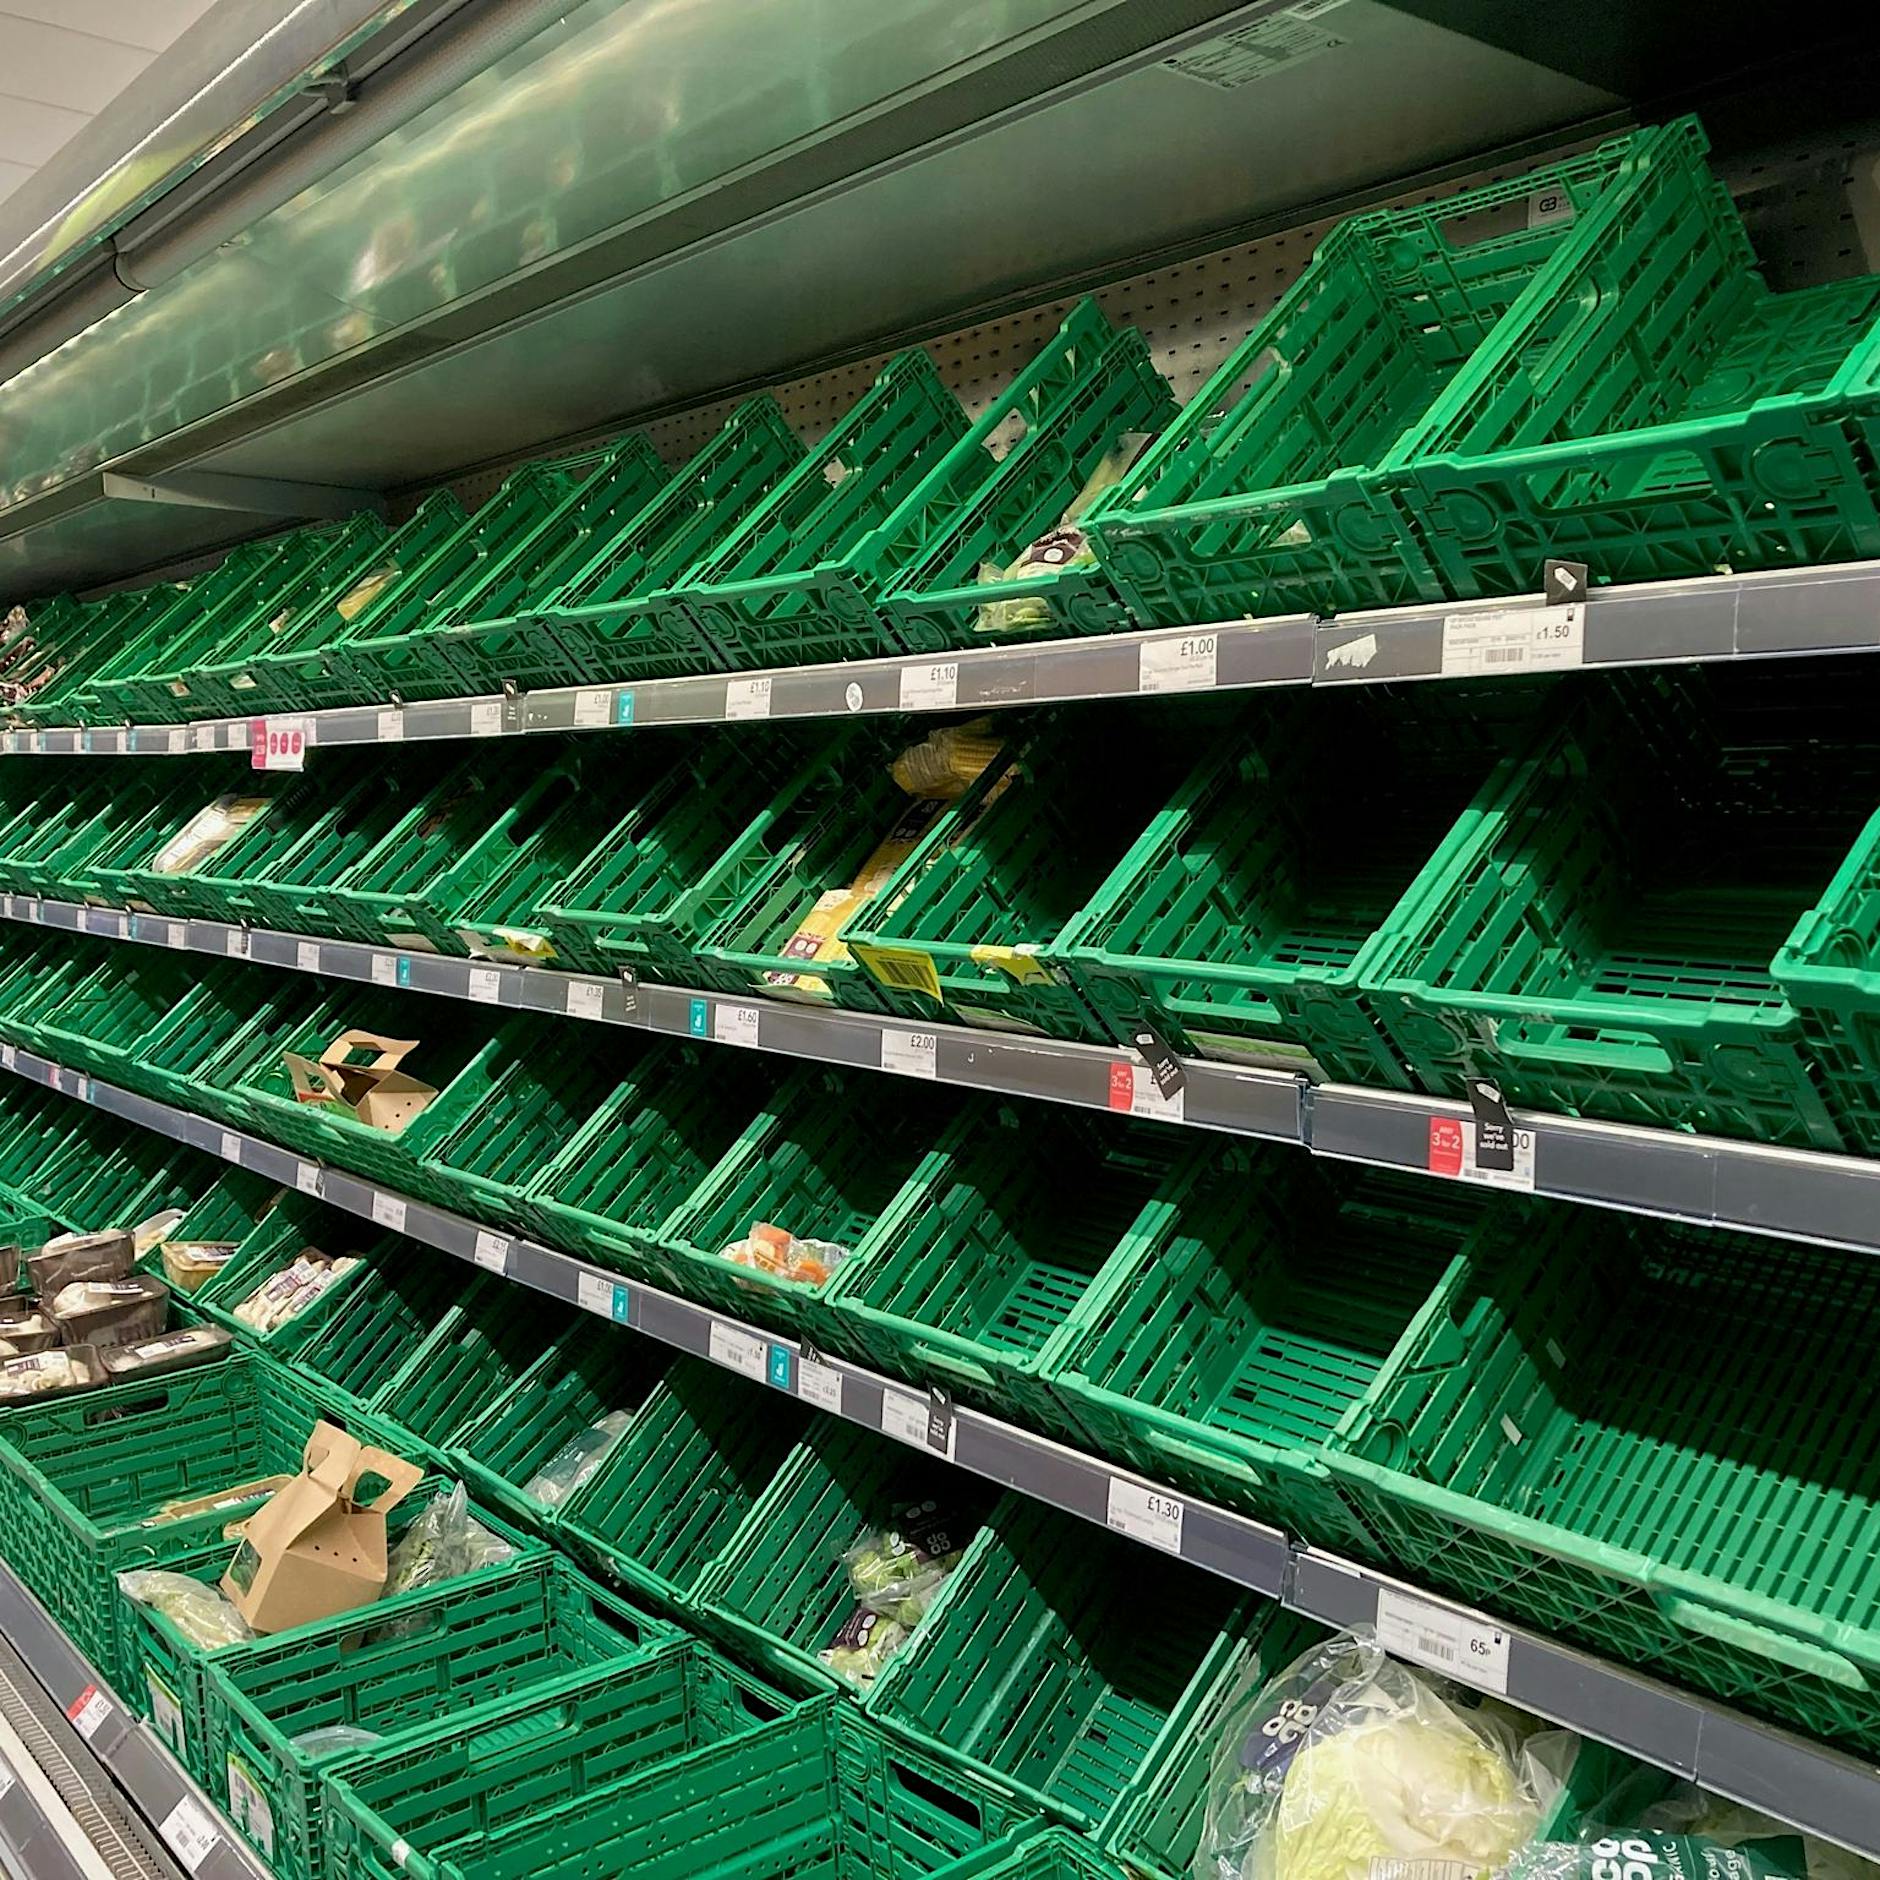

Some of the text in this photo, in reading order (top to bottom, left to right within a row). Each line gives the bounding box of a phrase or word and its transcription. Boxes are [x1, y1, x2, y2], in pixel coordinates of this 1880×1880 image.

[1536, 625, 1570, 640] £1.50
[1180, 637, 1214, 656] £1.00
[930, 665, 956, 681] £1.10
[737, 1009, 757, 1024] £1.60
[910, 1034, 935, 1050] £2.00
[1111, 1075, 1118, 1088] 3
[1125, 1078, 1131, 1089] 2
[1431, 1131, 1441, 1147] 3
[1451, 1135, 1461, 1150] 2
[1147, 1496, 1180, 1520] £1.30
[1470, 1638, 1491, 1656] 65p
